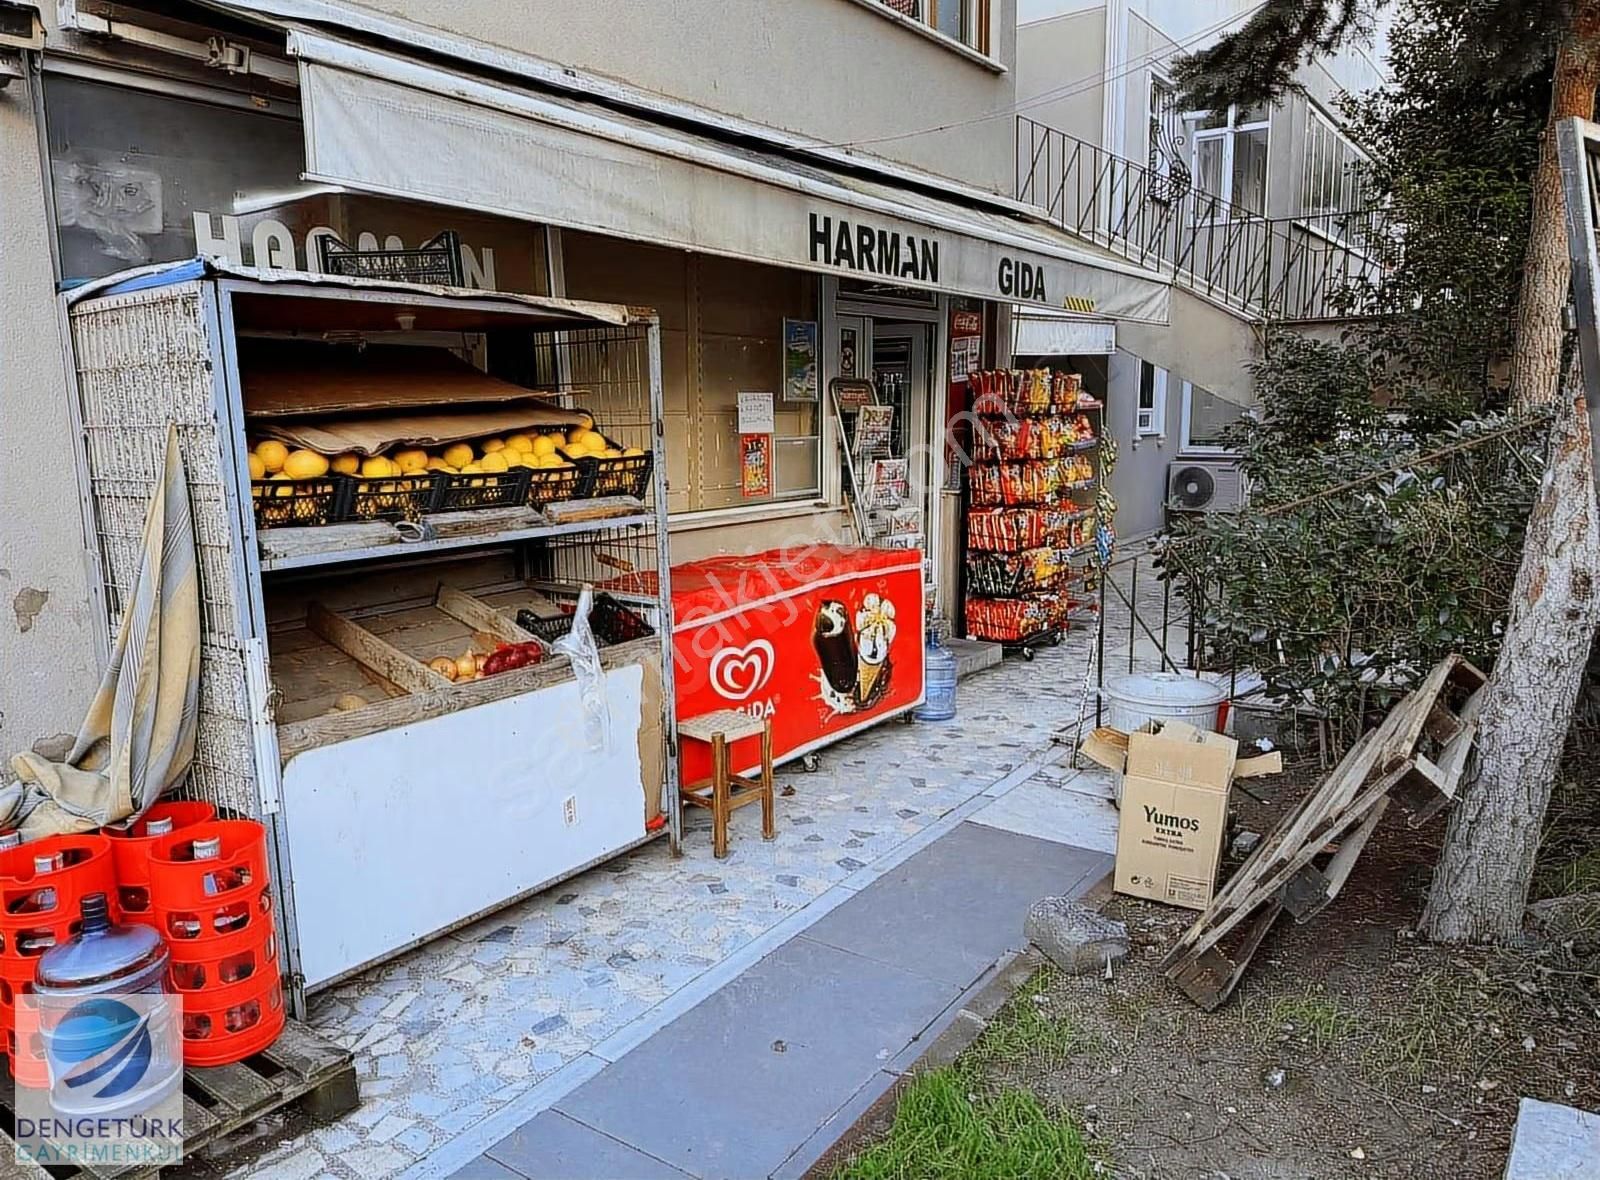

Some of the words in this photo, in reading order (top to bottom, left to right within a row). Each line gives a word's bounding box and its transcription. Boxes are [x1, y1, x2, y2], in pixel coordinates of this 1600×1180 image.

[808, 212, 940, 283] HARMAN
[997, 256, 1047, 302] GIDA
[1155, 827, 1183, 838] EXTRA
